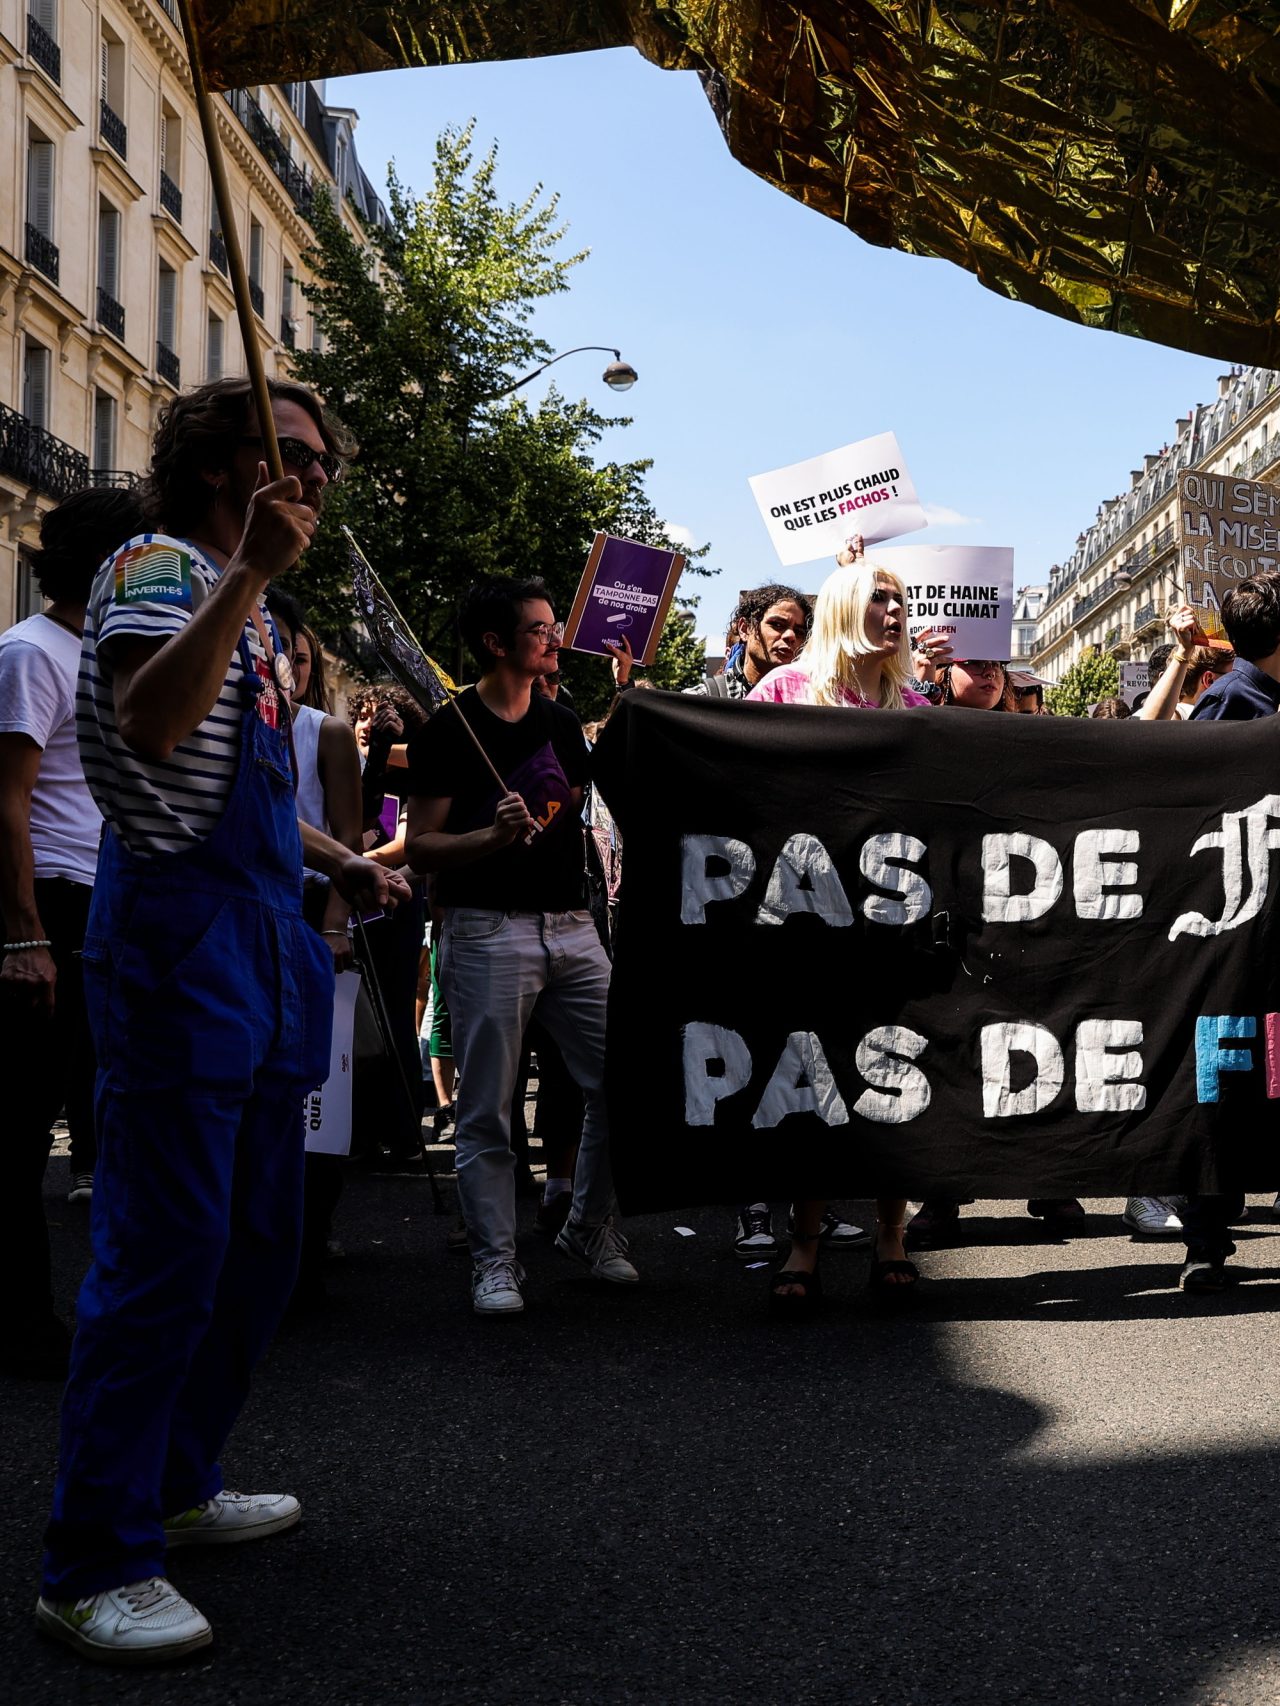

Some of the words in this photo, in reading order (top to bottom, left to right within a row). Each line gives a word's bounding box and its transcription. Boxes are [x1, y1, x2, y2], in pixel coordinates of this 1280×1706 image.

[770, 503, 791, 518] ON
[795, 496, 816, 514] EST
[819, 483, 852, 506] PLUS
[854, 468, 900, 491] CHAUD
[784, 514, 813, 531] QUE
[814, 507, 837, 524] LES
[838, 488, 890, 516] FACHOS
[892, 485, 899, 497] !
[1183, 475, 1224, 511] QUI
[1183, 511, 1213, 537] LA
[595, 588, 641, 603] TAMPONNE
[641, 597, 658, 606] PAS
[614, 581, 625, 590] On
[626, 584, 642, 593] s'en
[926, 585, 946, 600] DE
[950, 585, 999, 601] HAINE
[1185, 581, 1221, 612] LA
[598, 597, 609, 606] de
[610, 602, 625, 610] nos
[625, 603, 647, 613] droits
[917, 603, 939, 617] DU
[943, 603, 1000, 619] CLIMAT
[680, 833, 934, 926] PAS
[981, 829, 1143, 923] DE
[681, 1021, 931, 1129] PAS
[981, 1019, 1147, 1118] DE
[310, 1096, 323, 1132] QUE
